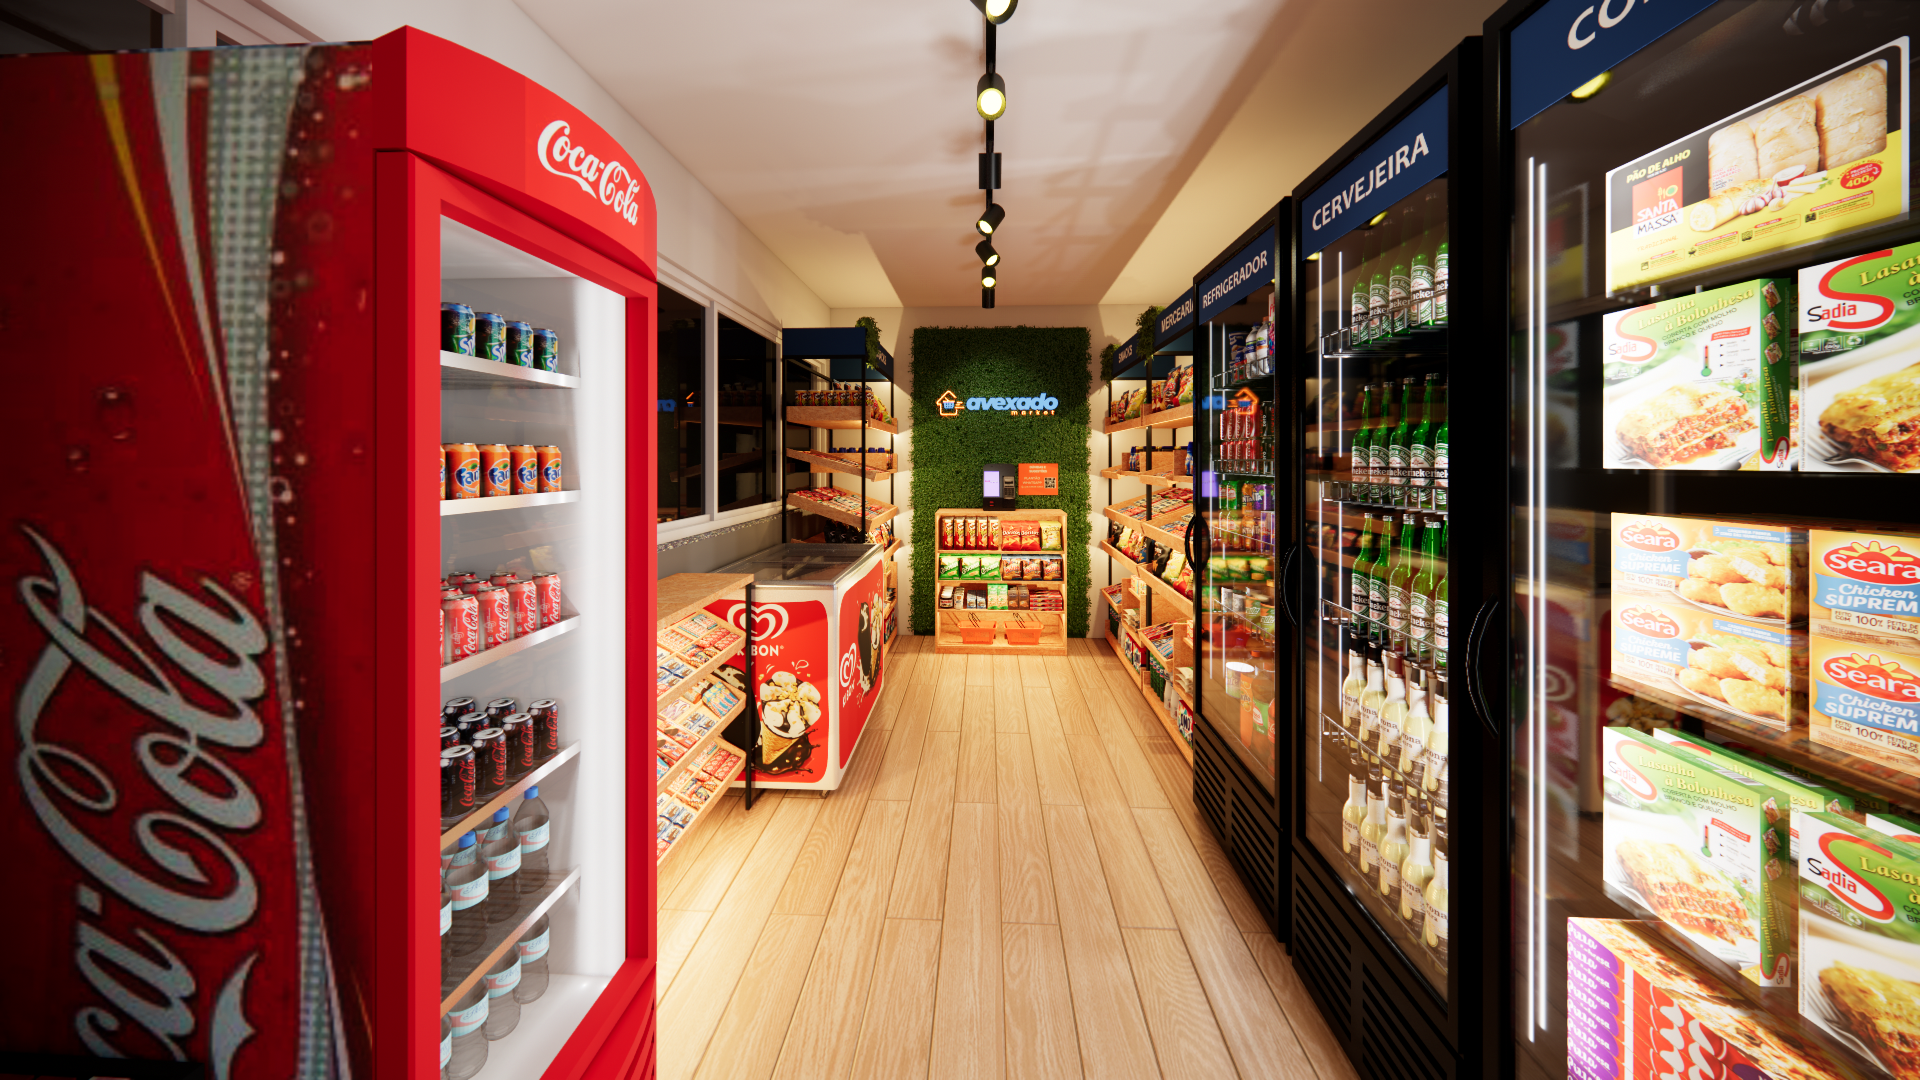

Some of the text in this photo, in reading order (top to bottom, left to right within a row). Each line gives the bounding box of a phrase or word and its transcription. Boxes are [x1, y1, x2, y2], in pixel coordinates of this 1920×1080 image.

[537, 119, 641, 226] Coca-Cola
[1626, 168, 1647, 184] PÃO
[1647, 161, 1661, 175] DE
[1662, 149, 1691, 168] ALHO
[1311, 132, 1430, 231] CERVEJEIRA
[1636, 198, 1679, 222] SANTA
[1637, 213, 1678, 235] MASSA
[1202, 250, 1268, 309] REFRIGERADOR
[1638, 298, 1696, 331] Lasanha
[1675, 287, 1755, 328] Bolonhesa
[1693, 320, 1709, 331] COM
[1710, 307, 1738, 322] MOLHO
[1807, 302, 1857, 322] Sadia
[1608, 342, 1637, 356] Sadia
[966, 393, 1059, 411] avexado
[1776, 448, 1784, 469] Sadia
[1622, 530, 1675, 549] Seara
[1620, 560, 1682, 574] SUPREME
[1627, 552, 1673, 564] Chicken
[1829, 553, 1920, 580] Seara
[1838, 583, 1918, 600] Chicken
[1825, 594, 1919, 614] SUPREM
[1622, 611, 1676, 636] Seara
[1887, 625, 1919, 635] FRANGO
[1620, 642, 1682, 663] SUPREME
[1627, 635, 1673, 650] Chicken
[1829, 662, 1920, 699] Seara
[1825, 702, 1919, 732] SUPREM
[1838, 693, 1918, 718] Chicken
[1887, 739, 1919, 754] FRANGO
[1910, 742, 1919, 750] DE
[1608, 760, 1637, 784] Sadia
[1637, 755, 1696, 779] Lasanha
[1676, 777, 1754, 808] Bolonhesa
[1807, 857, 1858, 895] Sadia
